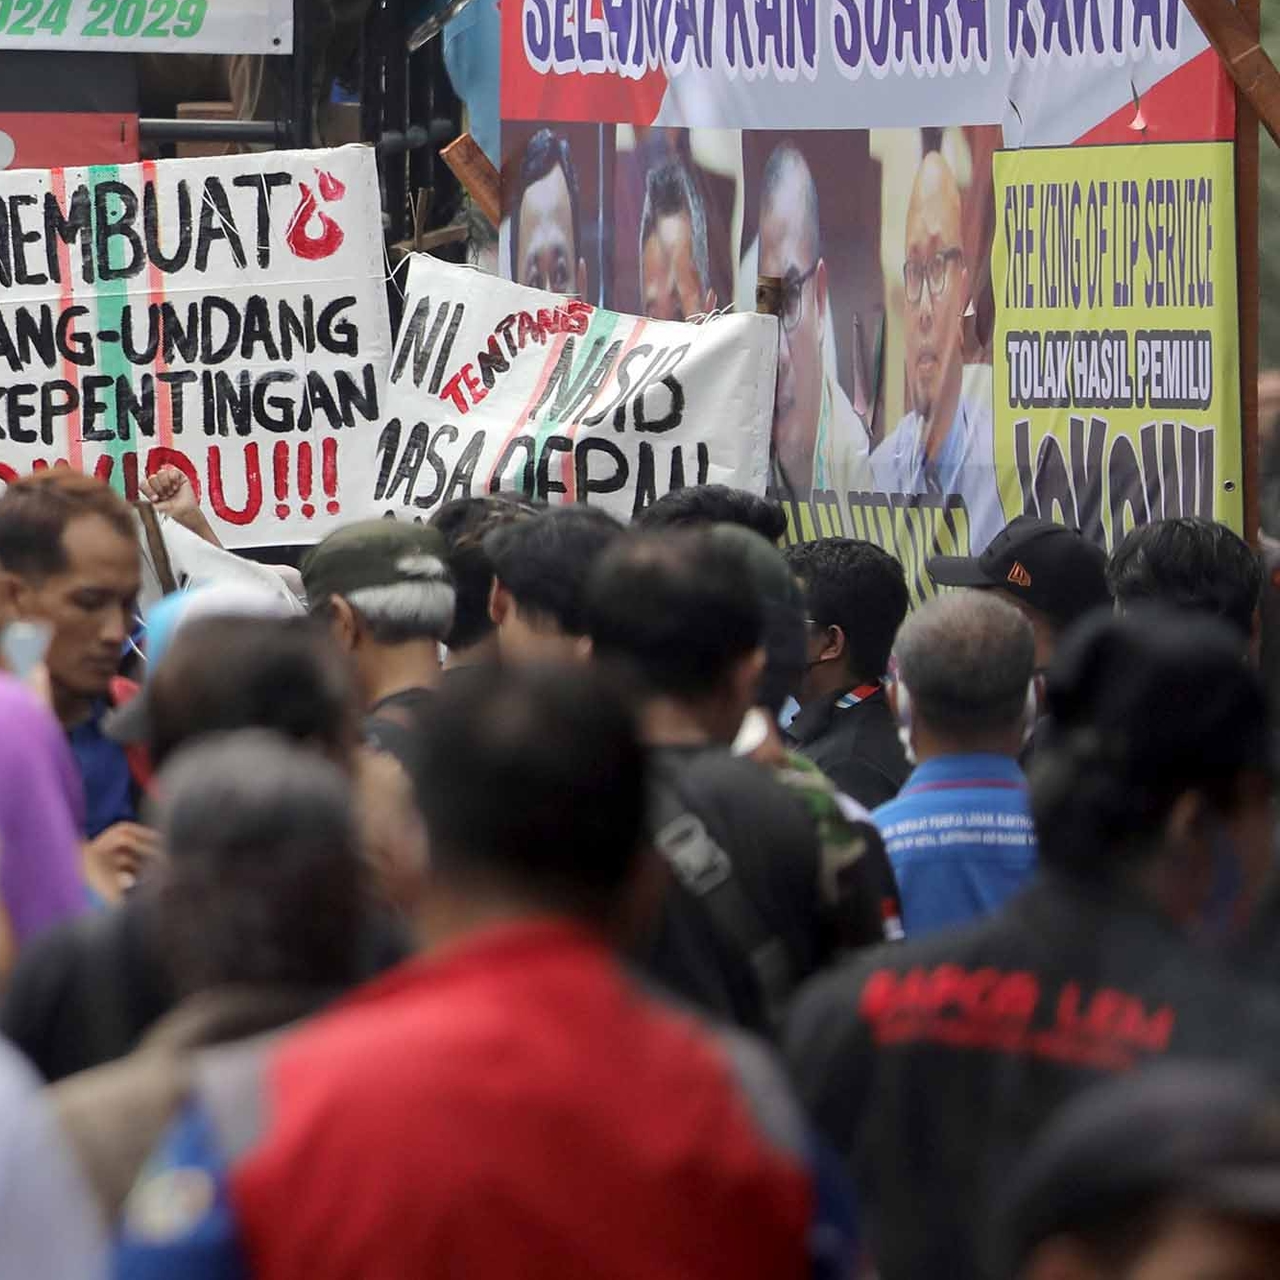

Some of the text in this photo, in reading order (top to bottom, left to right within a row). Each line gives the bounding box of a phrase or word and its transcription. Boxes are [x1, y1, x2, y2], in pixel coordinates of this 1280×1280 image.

[1005, 177, 1213, 310] THE KING OF LIP SERVICE
[440, 300, 594, 414] TENTANG
[1073, 331, 1134, 408] HASIL
[1136, 331, 1212, 410] PEMILU
